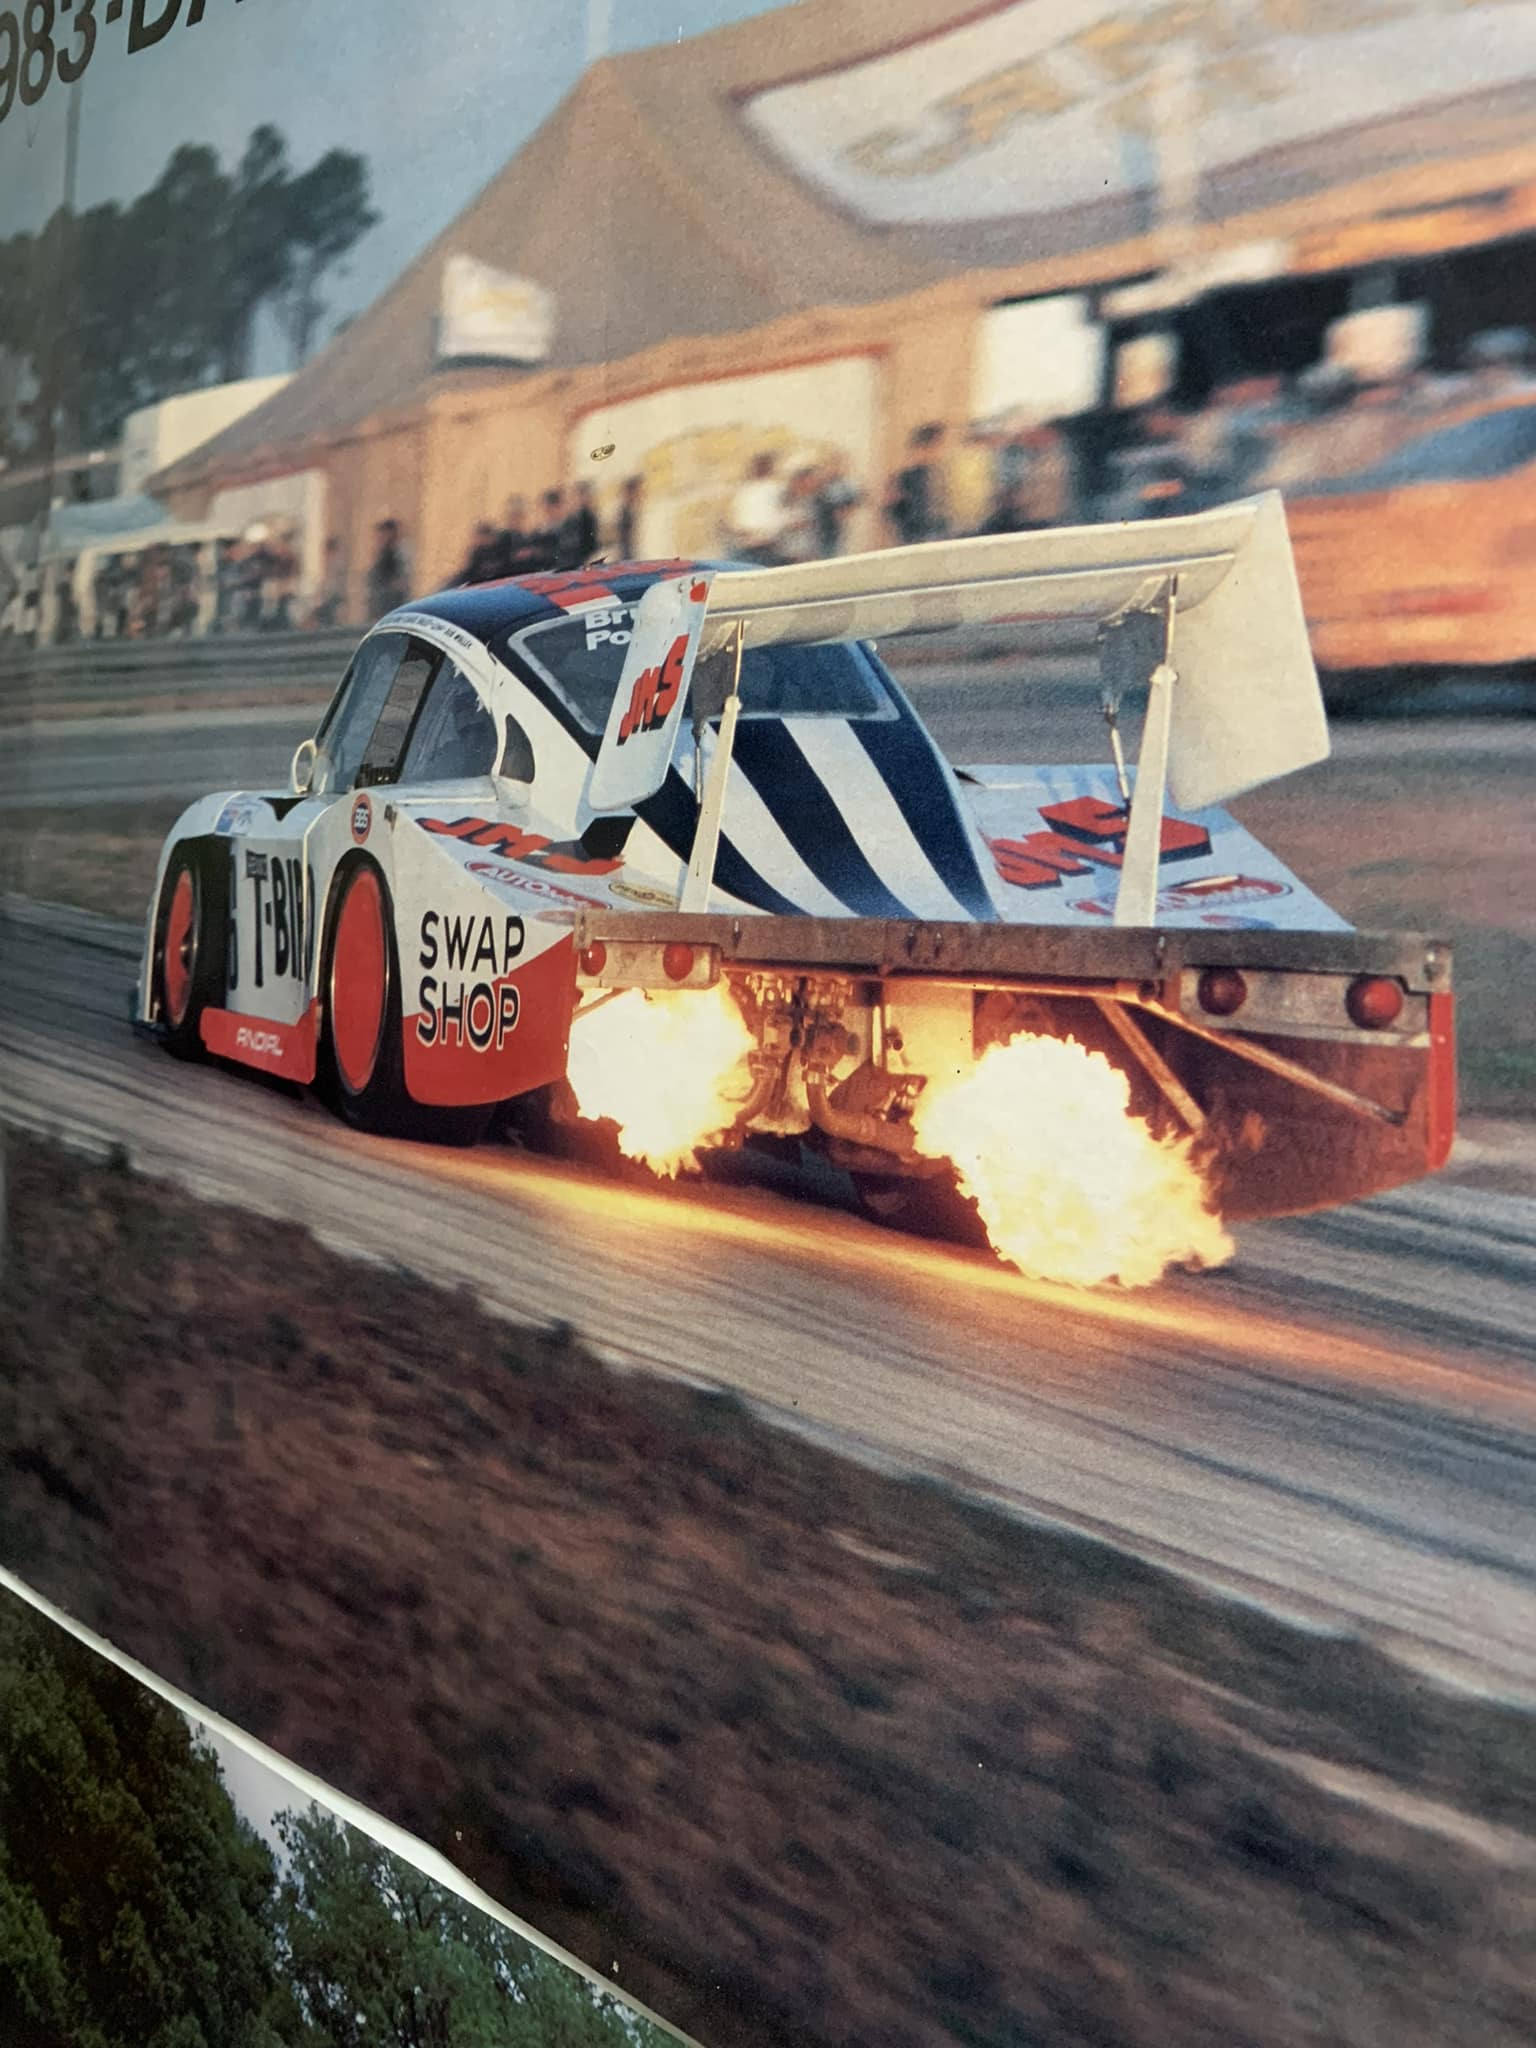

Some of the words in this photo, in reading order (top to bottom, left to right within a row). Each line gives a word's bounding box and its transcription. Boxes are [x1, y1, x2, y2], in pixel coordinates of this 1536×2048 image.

[617, 634, 690, 746] JMS
[354, 808, 368, 828] BBS
[418, 910, 525, 975] SWAP
[416, 975, 521, 1051] SHOP
